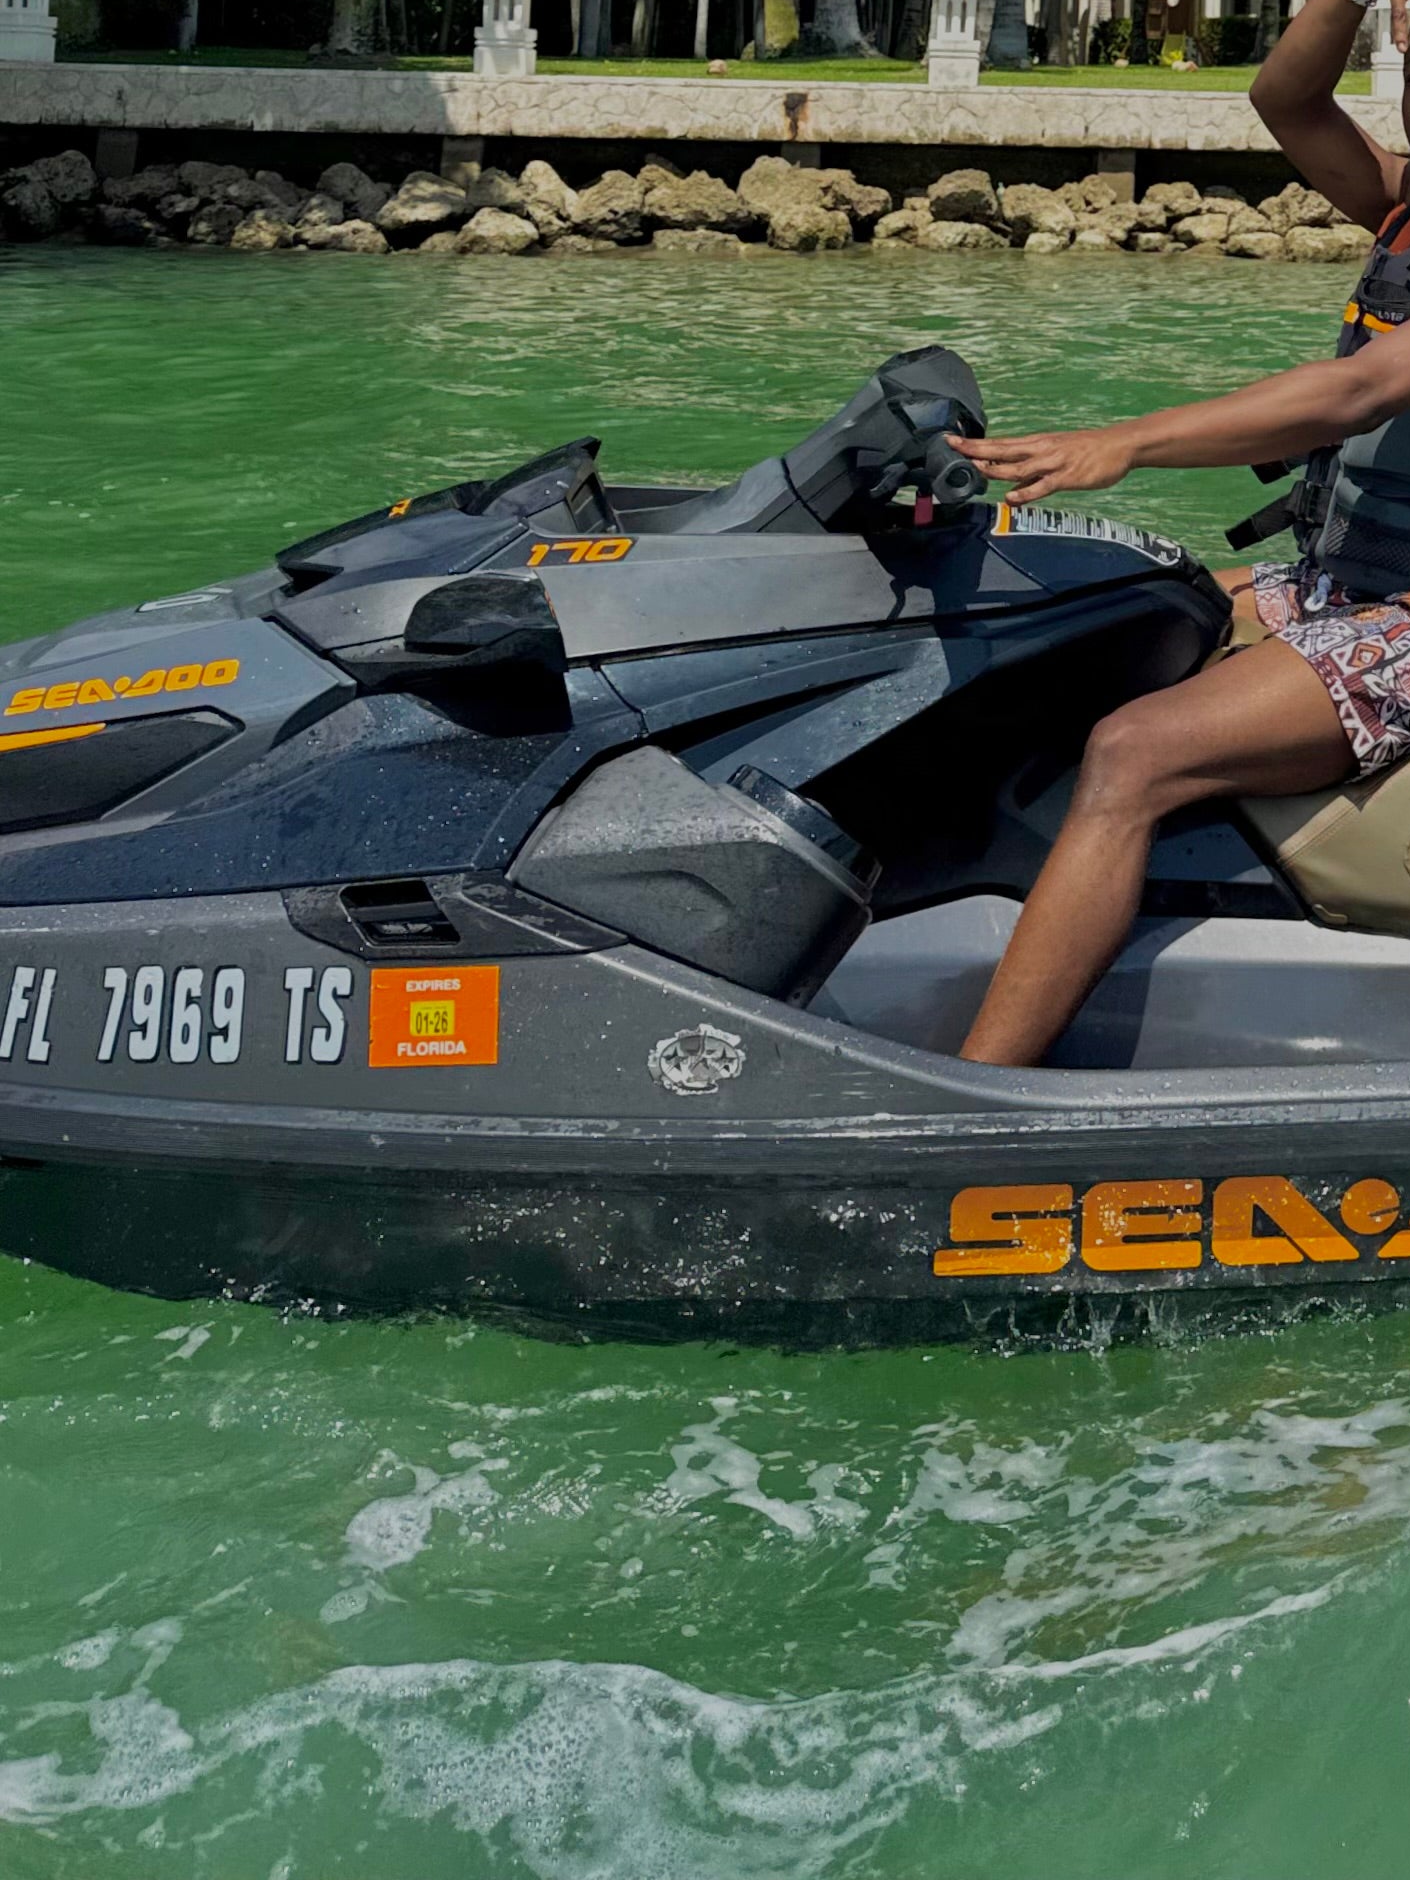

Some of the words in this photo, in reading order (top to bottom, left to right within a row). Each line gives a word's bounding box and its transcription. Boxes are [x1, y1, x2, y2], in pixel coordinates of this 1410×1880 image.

[526, 537, 634, 567] 170
[406, 978, 462, 993] EXPIRES
[0, 965, 57, 1062] FL
[97, 965, 247, 1064] 7969
[284, 966, 353, 1064] TS
[415, 1010, 449, 1034] 01-26
[397, 1039, 467, 1057] FLORIDA
